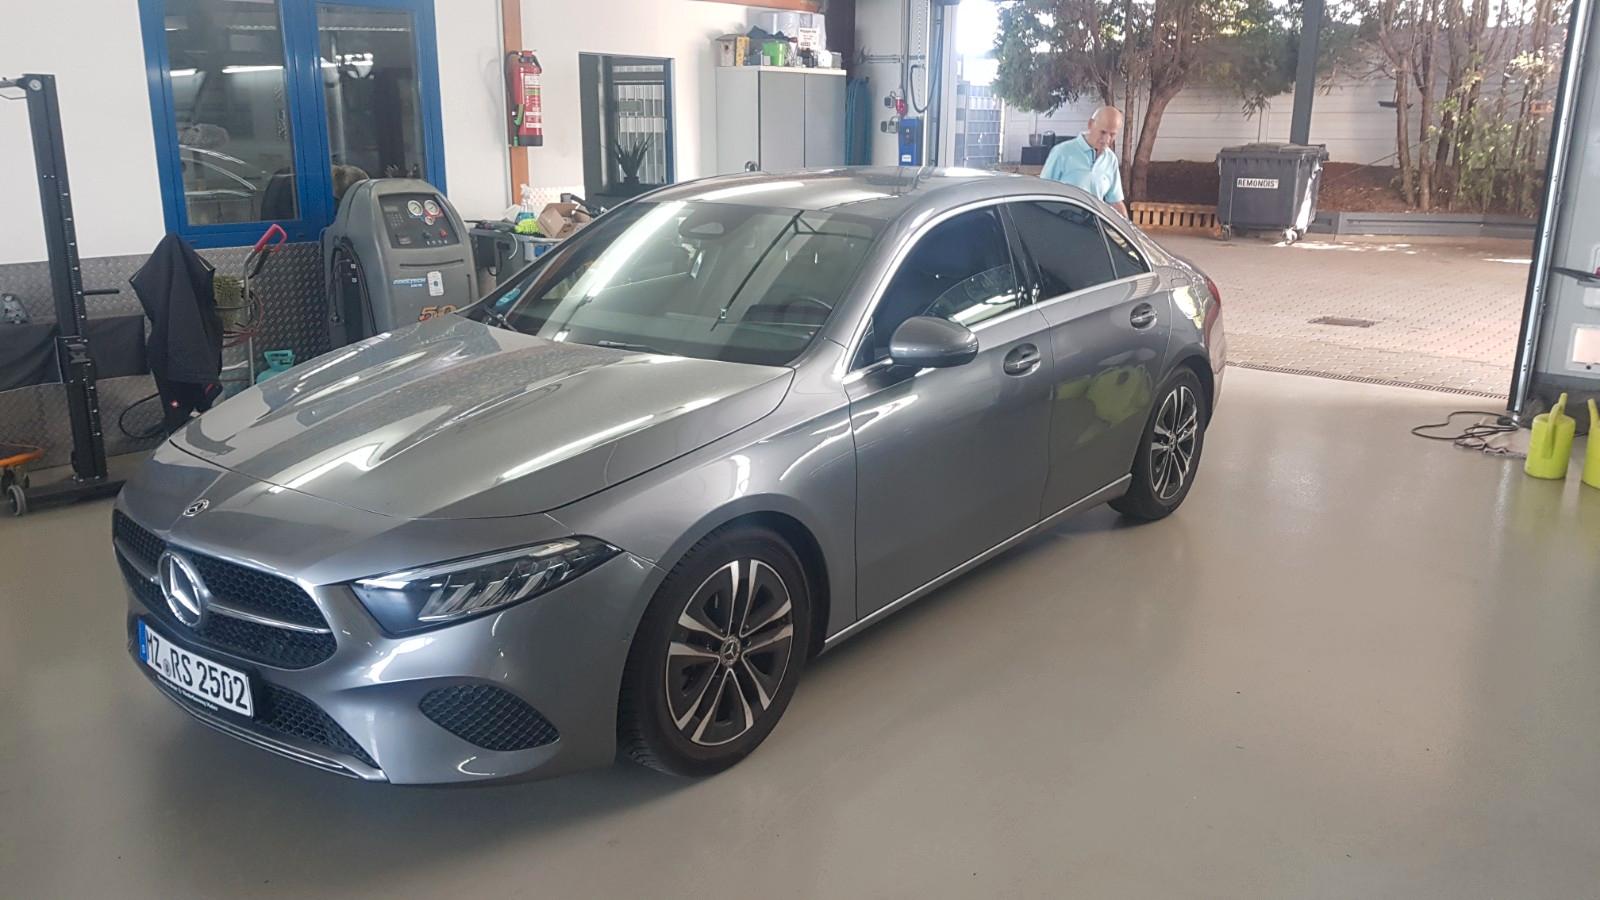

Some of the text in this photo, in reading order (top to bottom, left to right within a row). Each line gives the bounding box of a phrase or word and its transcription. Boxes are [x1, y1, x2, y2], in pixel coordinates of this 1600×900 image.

[1237, 179, 1275, 188] REMONDIS
[170, 648, 194, 687] RS
[196, 661, 248, 710] 2502
